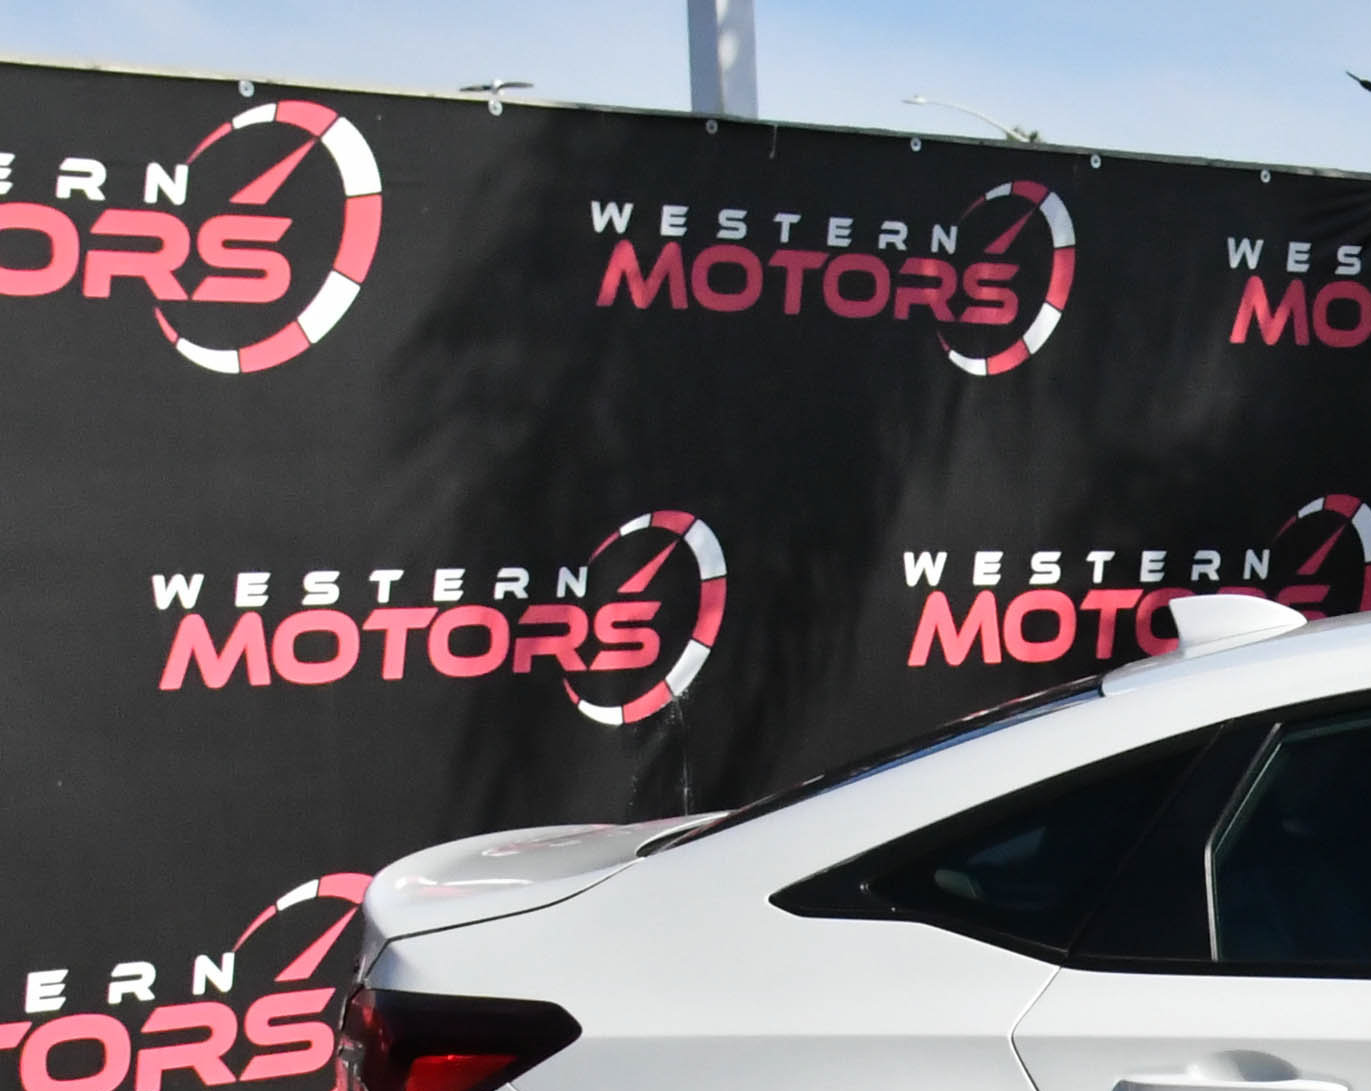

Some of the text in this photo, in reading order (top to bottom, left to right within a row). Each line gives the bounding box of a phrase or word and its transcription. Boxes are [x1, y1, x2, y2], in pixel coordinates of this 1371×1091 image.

[0, 201, 292, 303] ORS
[592, 201, 957, 254] WESTERN
[597, 240, 1018, 324] MOTORS
[152, 567, 588, 609] WESTERN
[904, 550, 1270, 586] WESTERN
[158, 600, 662, 691] MOTORS
[907, 586, 1329, 667] MOTO
[25, 951, 235, 1014] ERN
